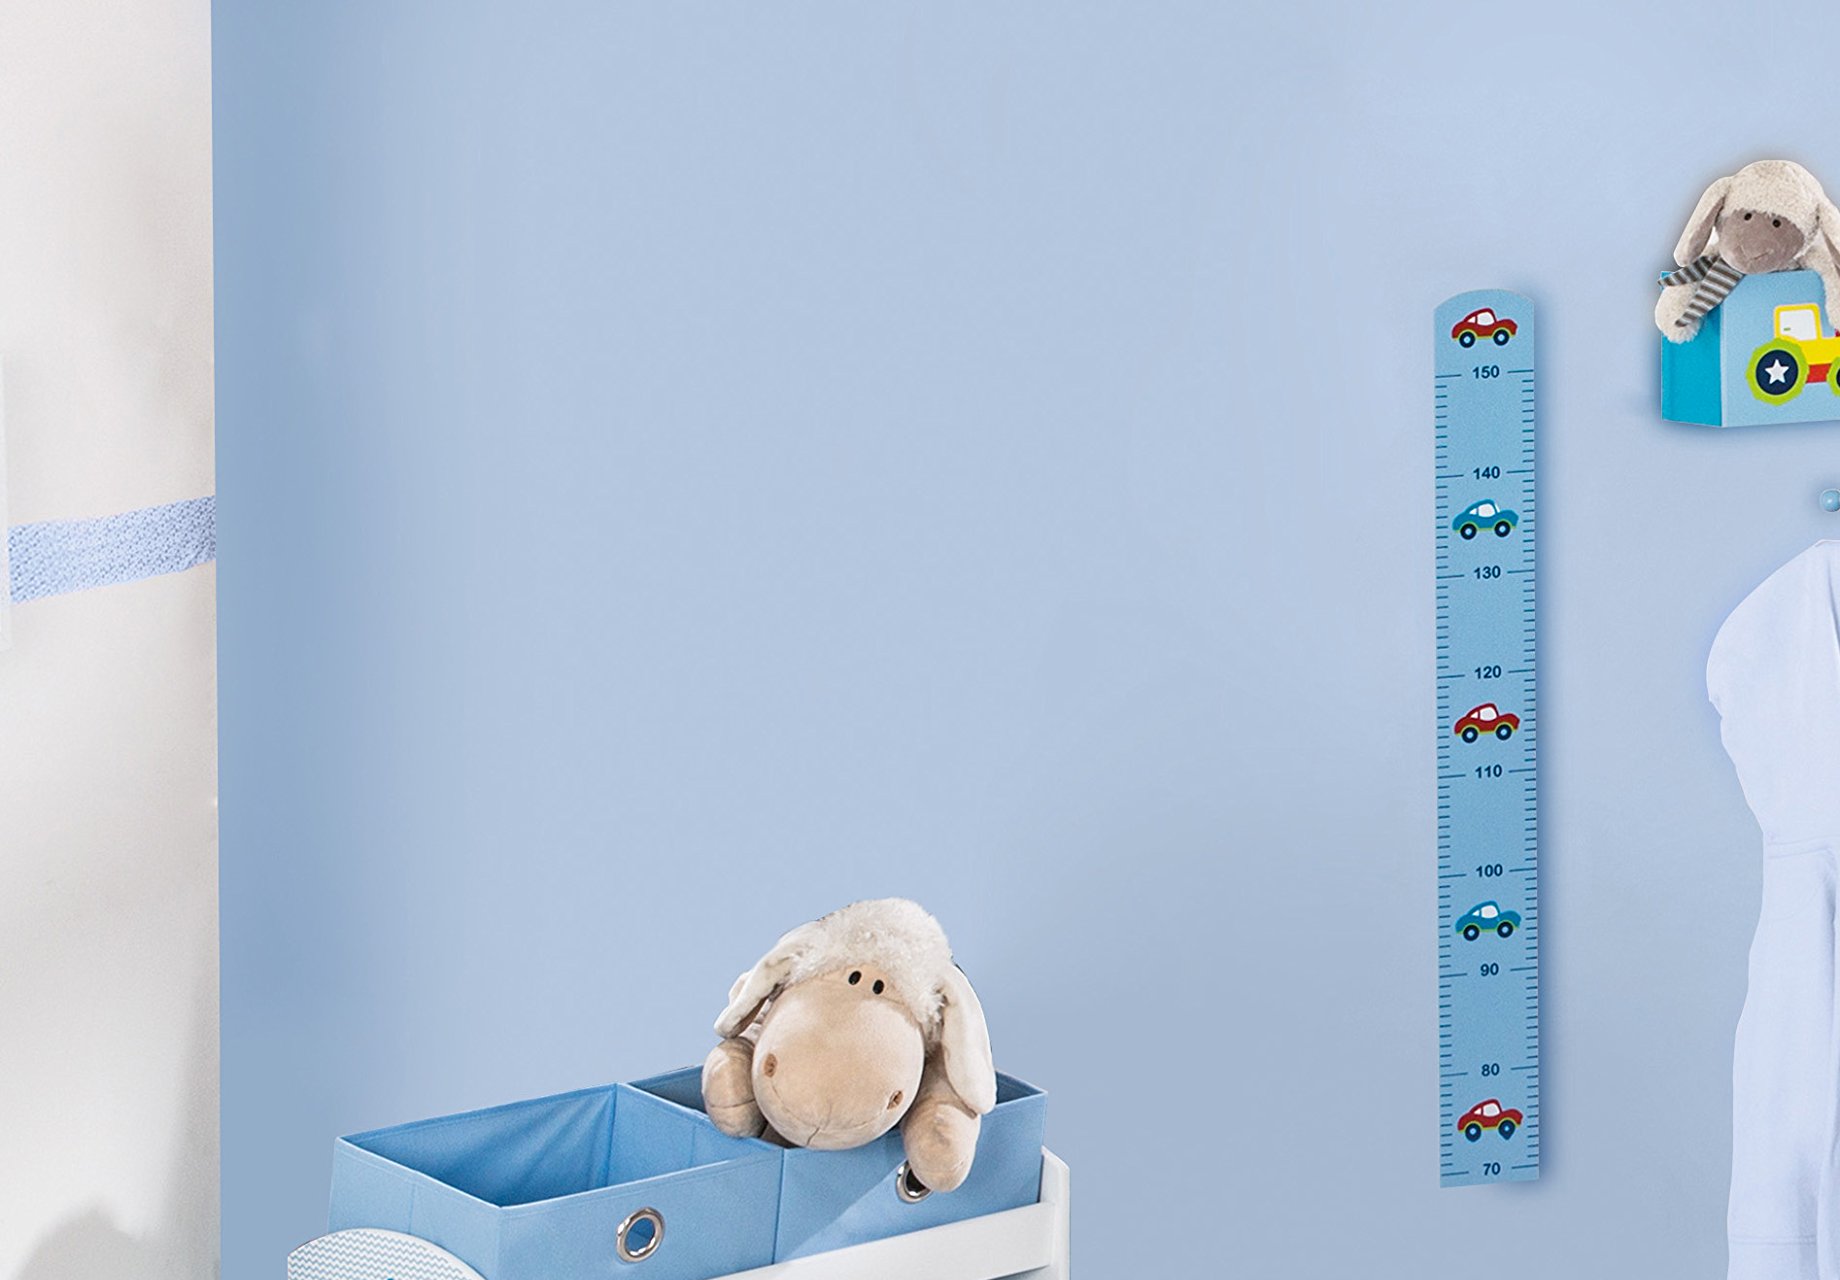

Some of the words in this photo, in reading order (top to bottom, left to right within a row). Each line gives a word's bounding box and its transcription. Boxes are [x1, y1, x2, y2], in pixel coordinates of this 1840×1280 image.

[1472, 364, 1500, 379] 150
[1473, 465, 1501, 480] 140
[1473, 565, 1501, 580] 130
[1474, 664, 1502, 680] 120
[1475, 764, 1503, 779] 110
[1476, 863, 1503, 878] 100
[1480, 962, 1500, 977] 90
[1481, 1062, 1500, 1077] 80
[1483, 1161, 1501, 1176] 70
